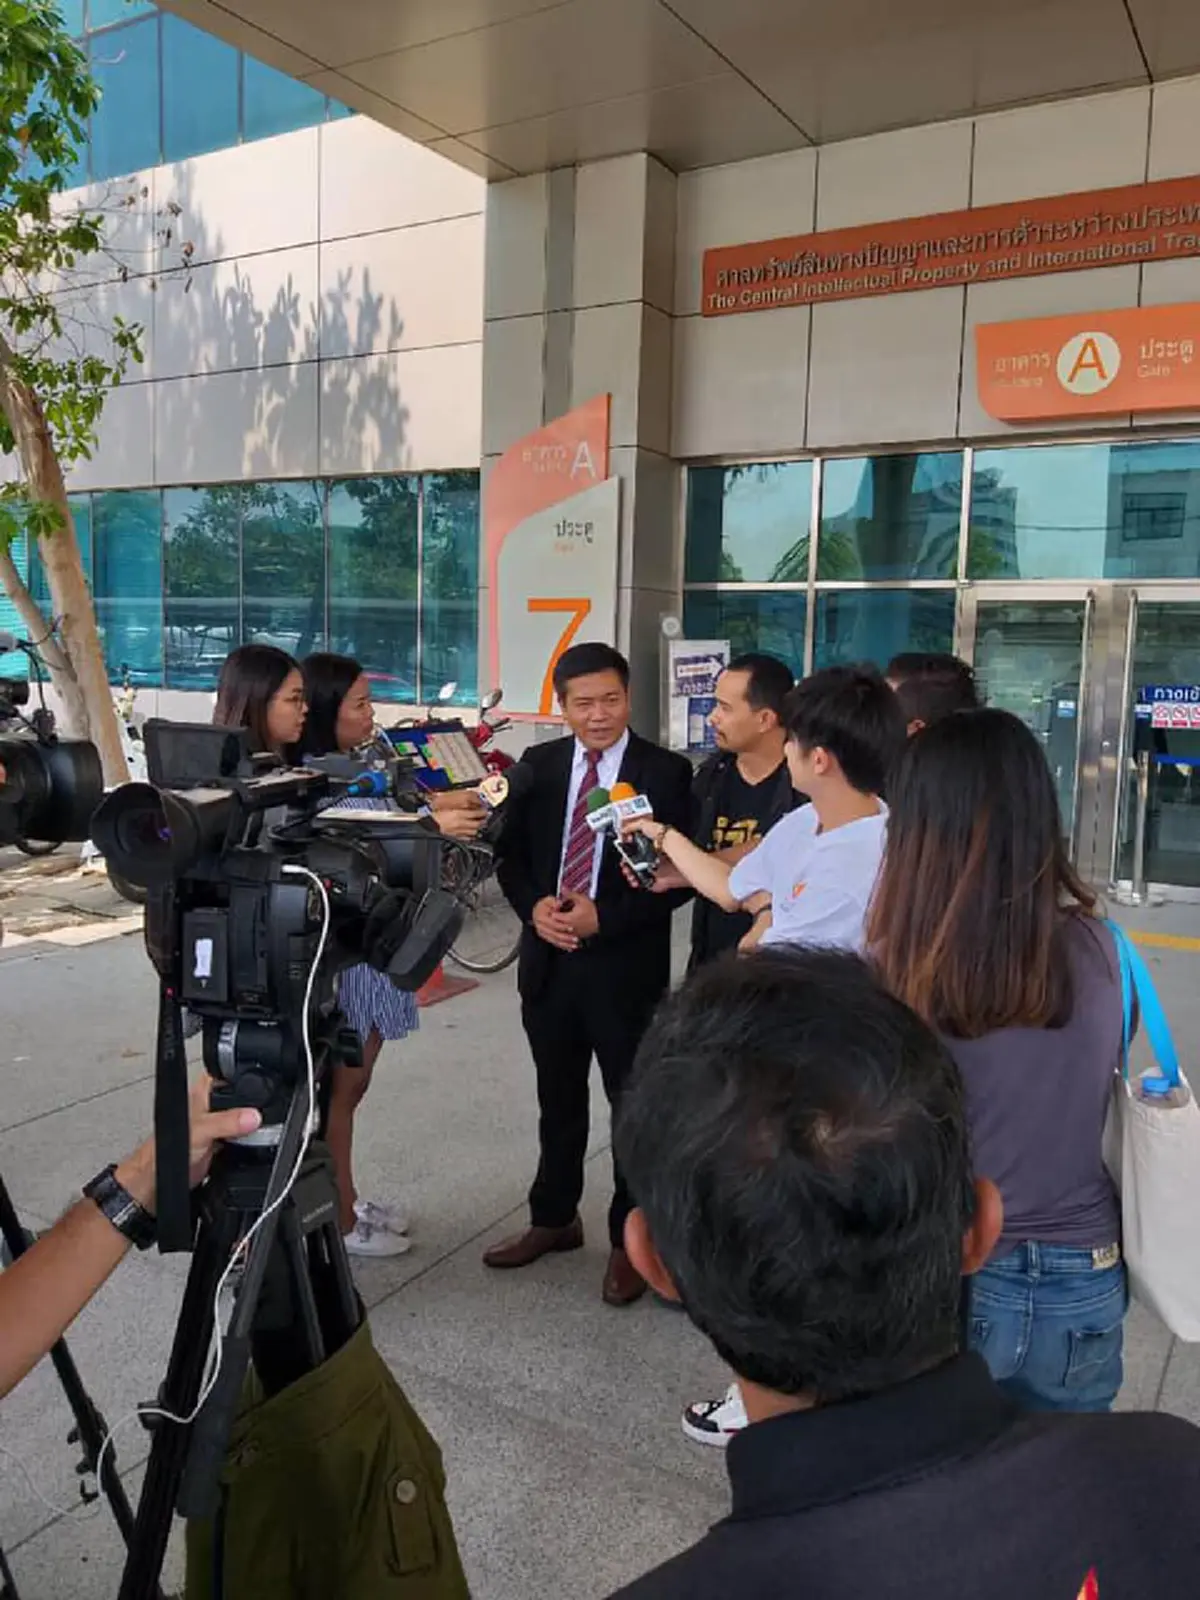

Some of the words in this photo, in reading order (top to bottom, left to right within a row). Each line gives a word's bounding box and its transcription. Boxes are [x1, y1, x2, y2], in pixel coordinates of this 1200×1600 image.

[708, 292, 737, 309] The
[741, 281, 799, 305] Central
[803, 269, 896, 297] Intellectual
[901, 261, 980, 285] Property
[985, 252, 1022, 275] and
[1027, 235, 1157, 270] International
[1163, 231, 1200, 250] Tra
[1067, 337, 1108, 384] A
[1139, 338, 1194, 364] ประตู
[570, 440, 597, 480] A
[527, 597, 592, 716] 7
